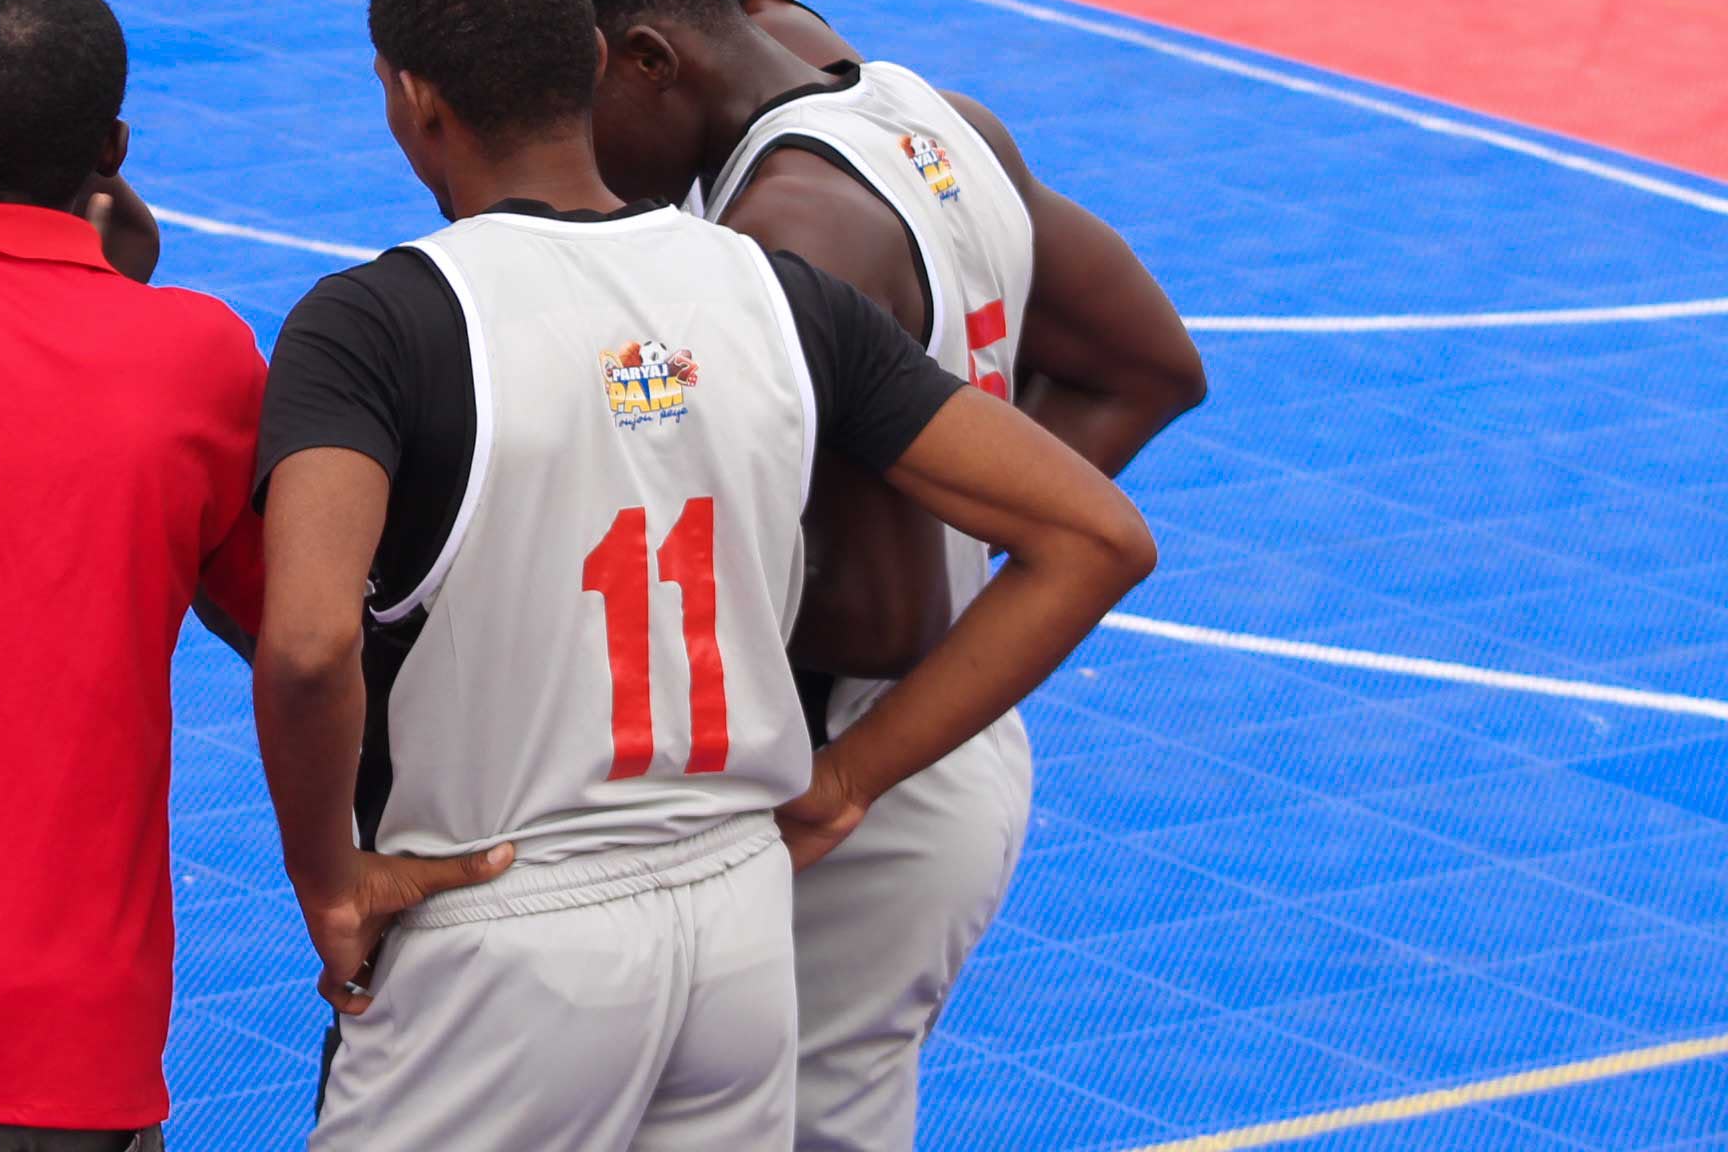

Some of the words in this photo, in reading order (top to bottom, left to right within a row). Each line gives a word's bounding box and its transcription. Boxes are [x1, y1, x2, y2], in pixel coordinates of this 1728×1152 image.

[612, 363, 669, 382] PARYAJ
[609, 376, 684, 413] PAM
[581, 496, 729, 782] 11
